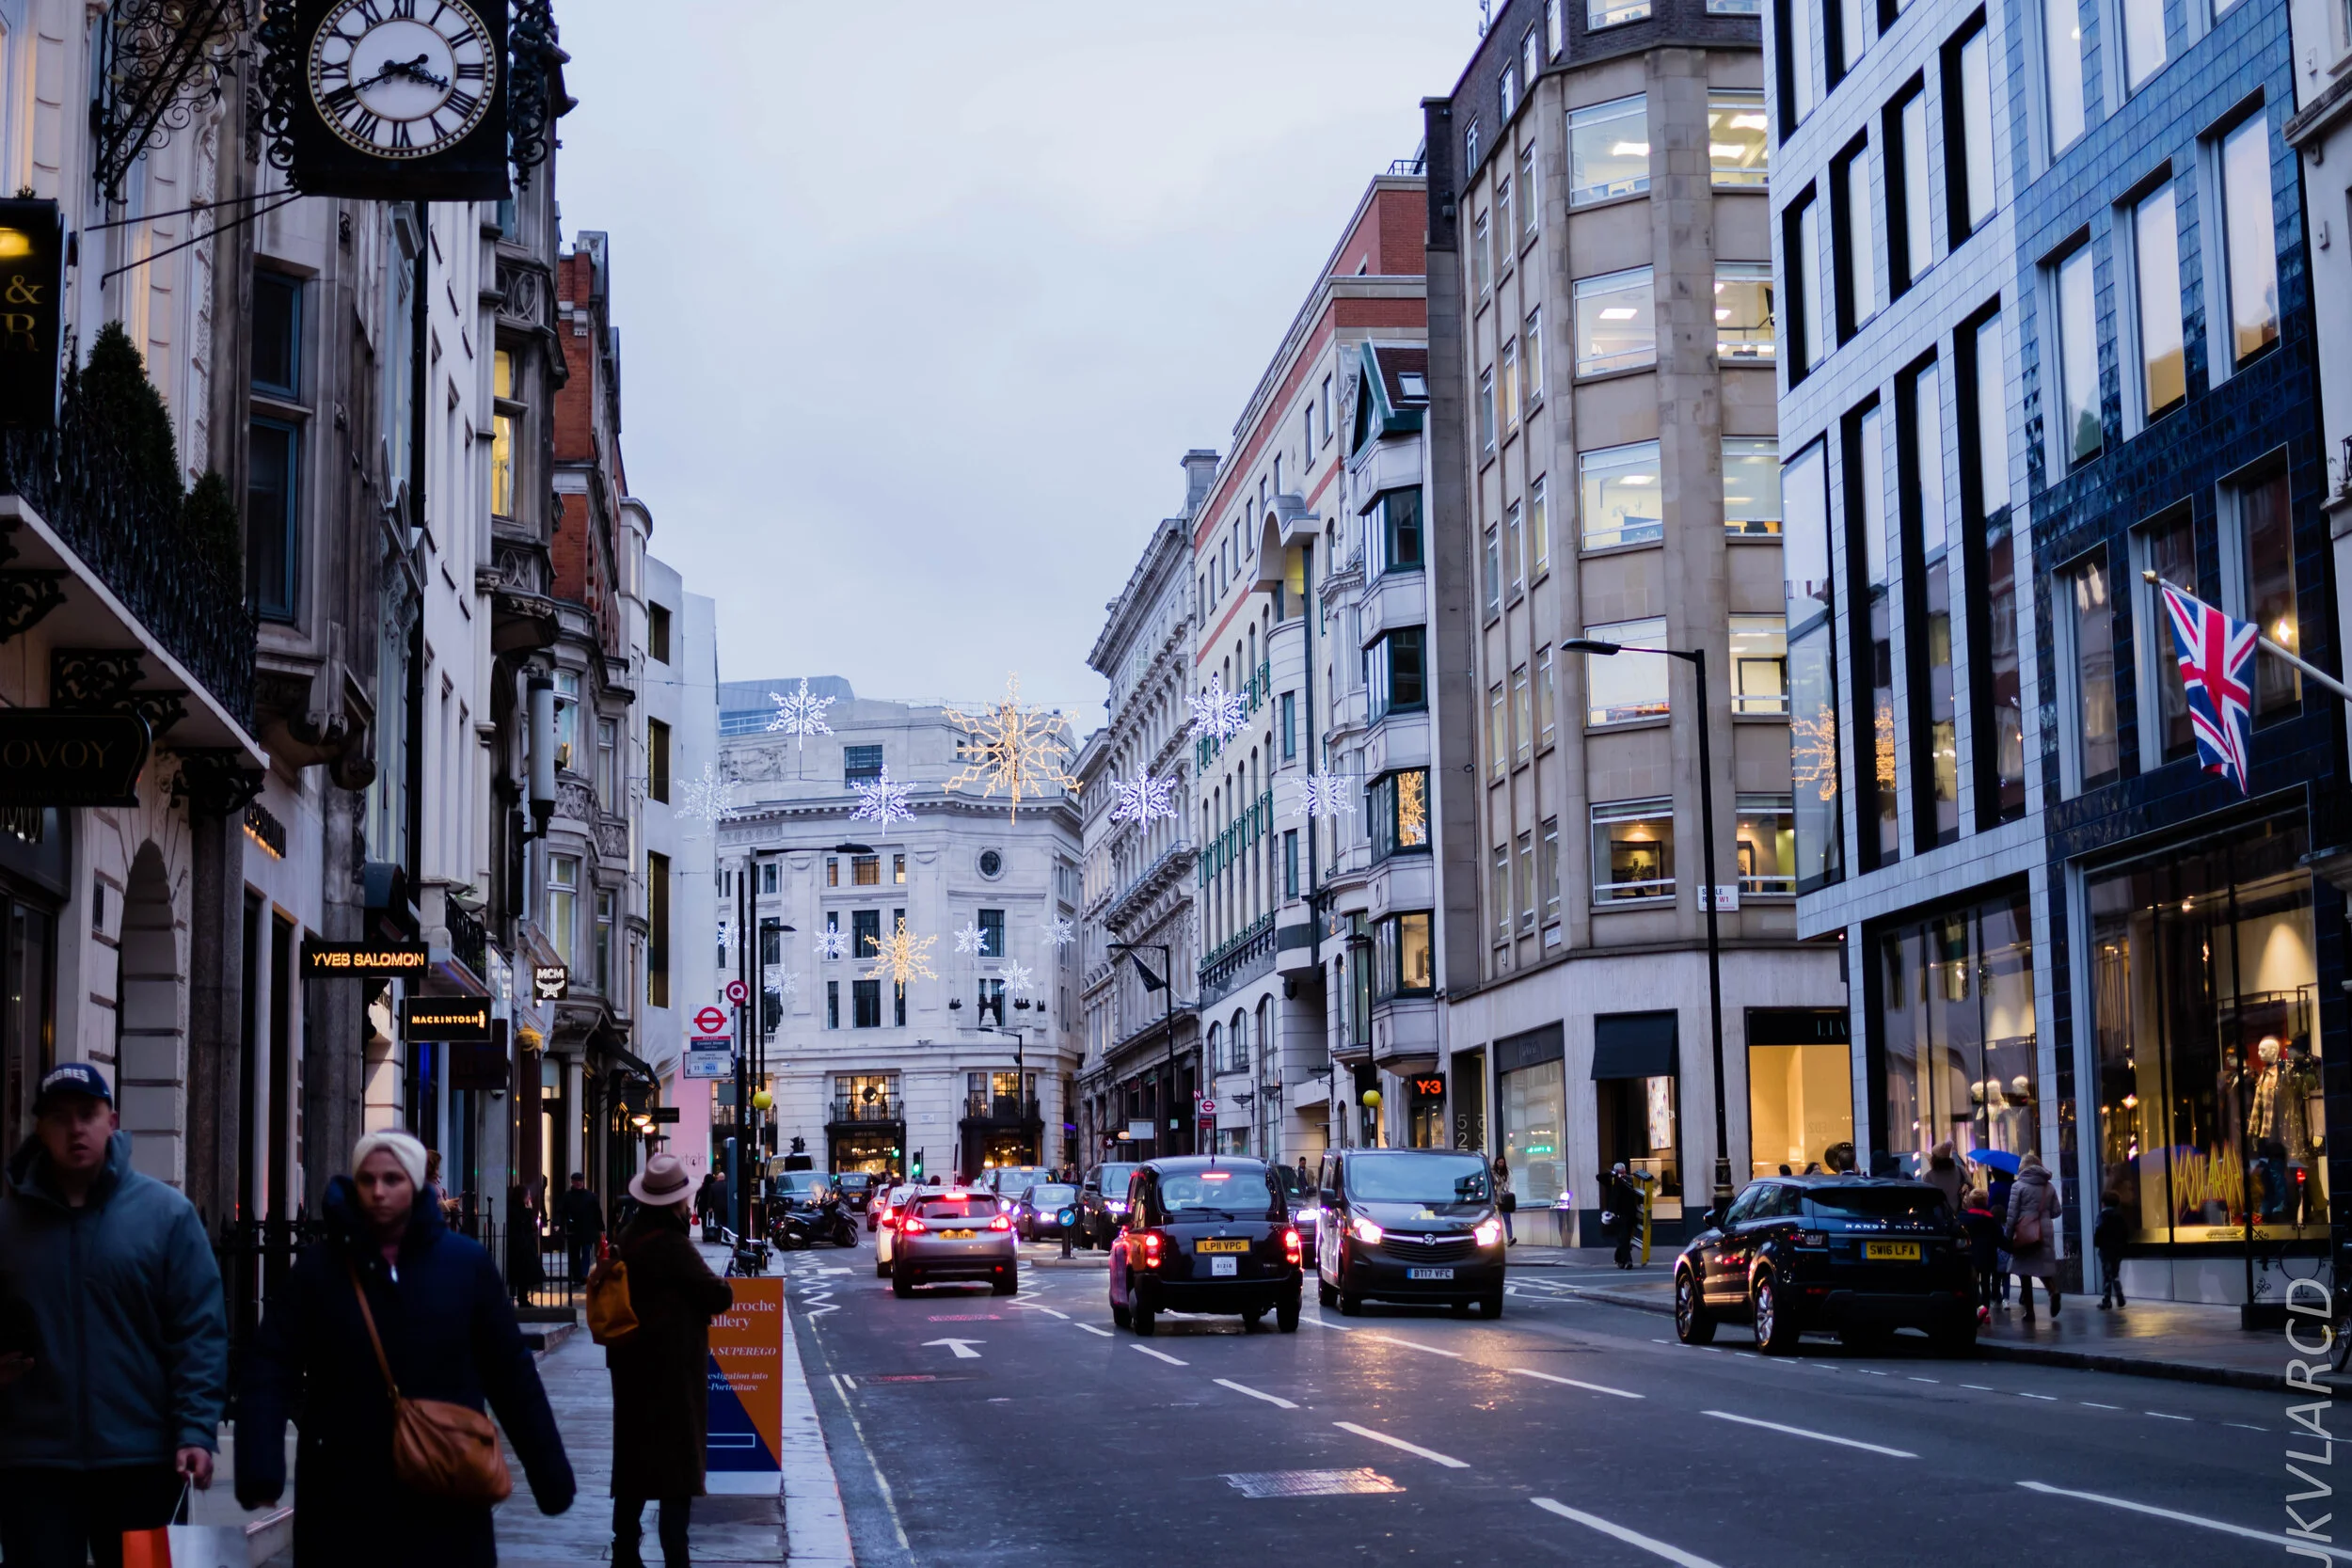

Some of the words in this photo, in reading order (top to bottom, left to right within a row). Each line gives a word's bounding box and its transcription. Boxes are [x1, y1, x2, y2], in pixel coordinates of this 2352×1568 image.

[5, 274, 44, 305] &
[1702, 887, 1724, 895] SLE
[312, 952, 351, 967] YVES
[353, 952, 424, 967] SALOMON
[535, 968, 564, 979] MCM
[729, 984, 744, 999] Q
[411, 1015, 479, 1024] MACKINTOSH
[1416, 1080, 1441, 1095] Y-3
[1224, 1241, 1242, 1250] VPG
[1869, 1244, 1893, 1255] SW16
[1895, 1244, 1915, 1256] LFA
[731, 1299, 776, 1311] iroche
[711, 1314, 751, 1331] allery
[718, 1346, 777, 1356] SUPEREGO
[707, 1370, 750, 1383] estigation
[752, 1370, 769, 1380] into
[707, 1382, 758, 1392] -Portraiture
